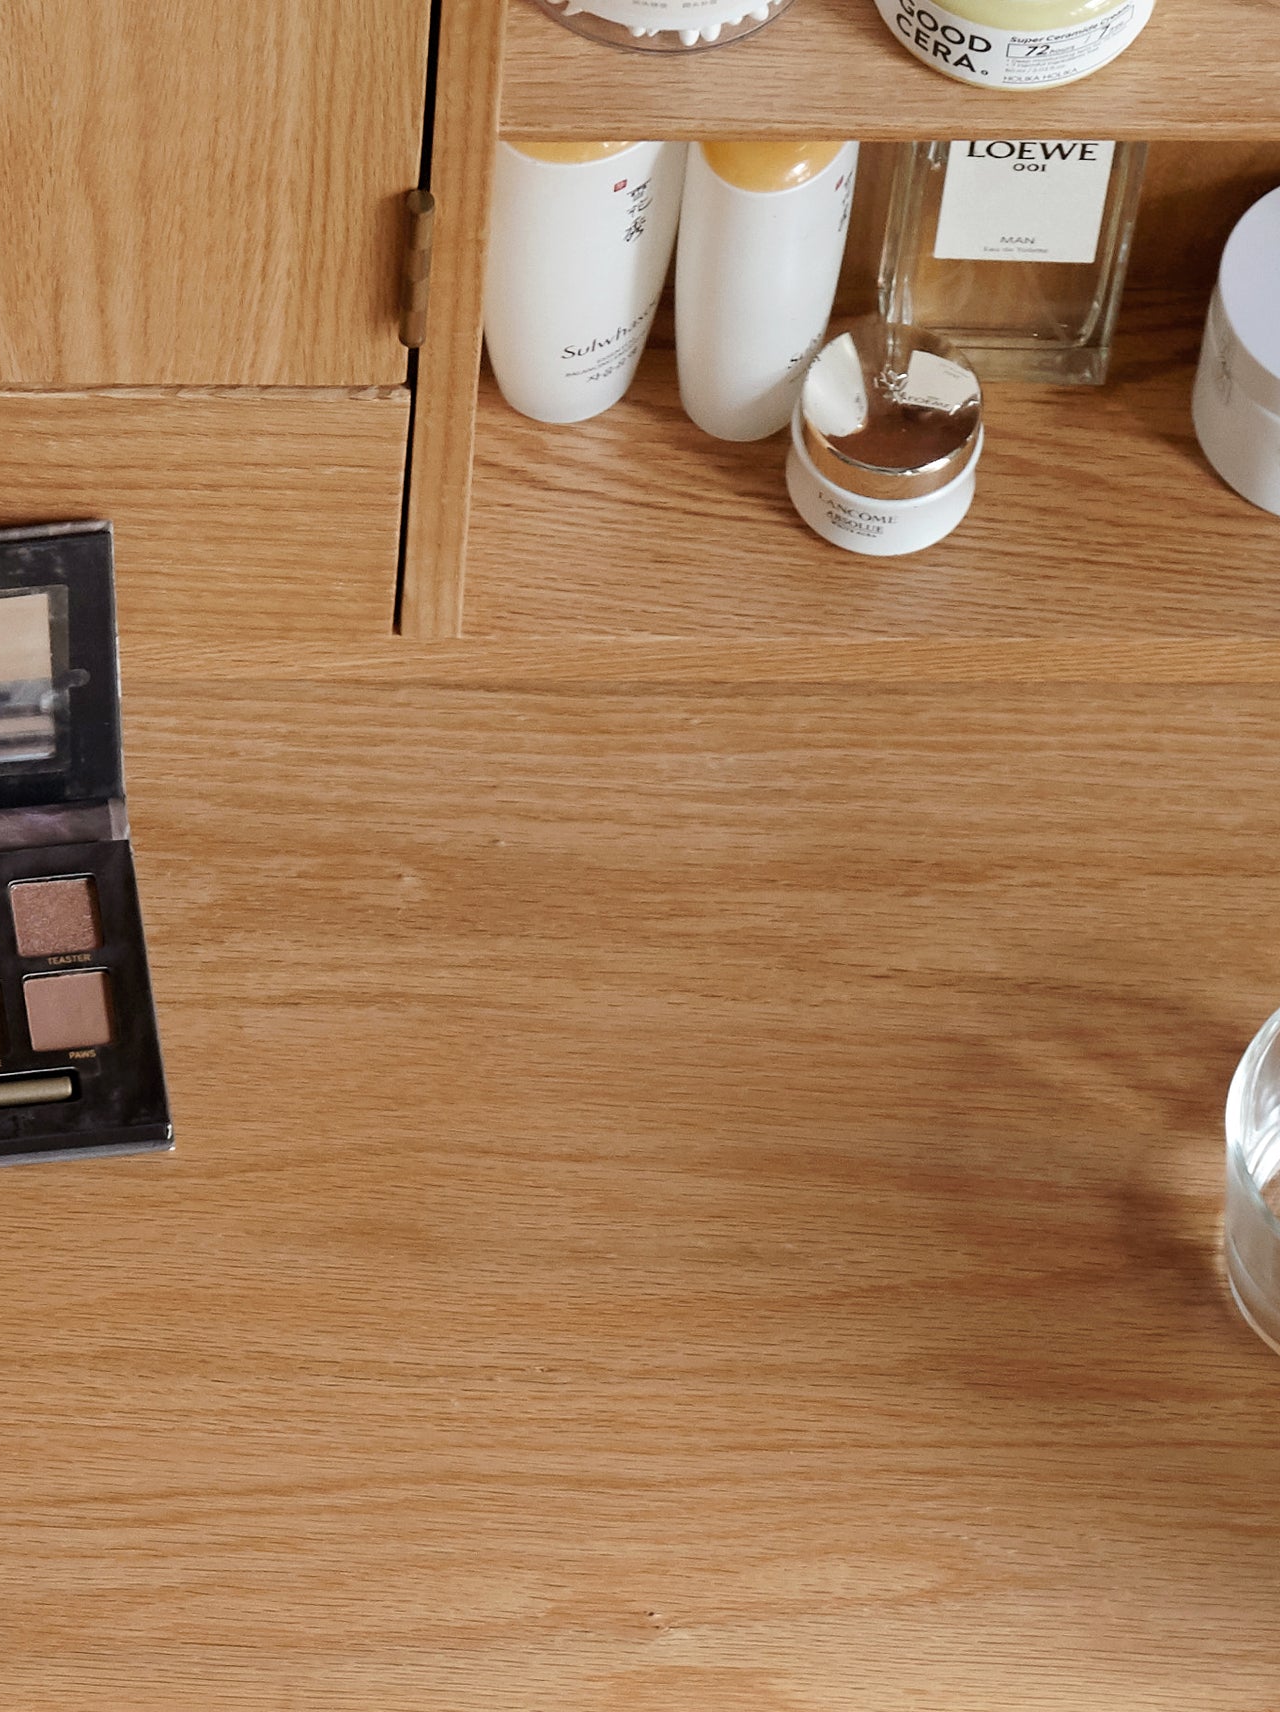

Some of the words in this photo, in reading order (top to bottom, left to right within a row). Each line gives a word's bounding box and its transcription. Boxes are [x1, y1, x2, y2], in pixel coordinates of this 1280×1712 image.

[1010, 34, 1044, 44] Super
[1024, 44, 1051, 57] 72
[966, 140, 1101, 162] LOEWE
[999, 236, 1036, 245] MAN
[46, 953, 93, 966] TEASTER
[68, 1049, 98, 1060] PAWS
